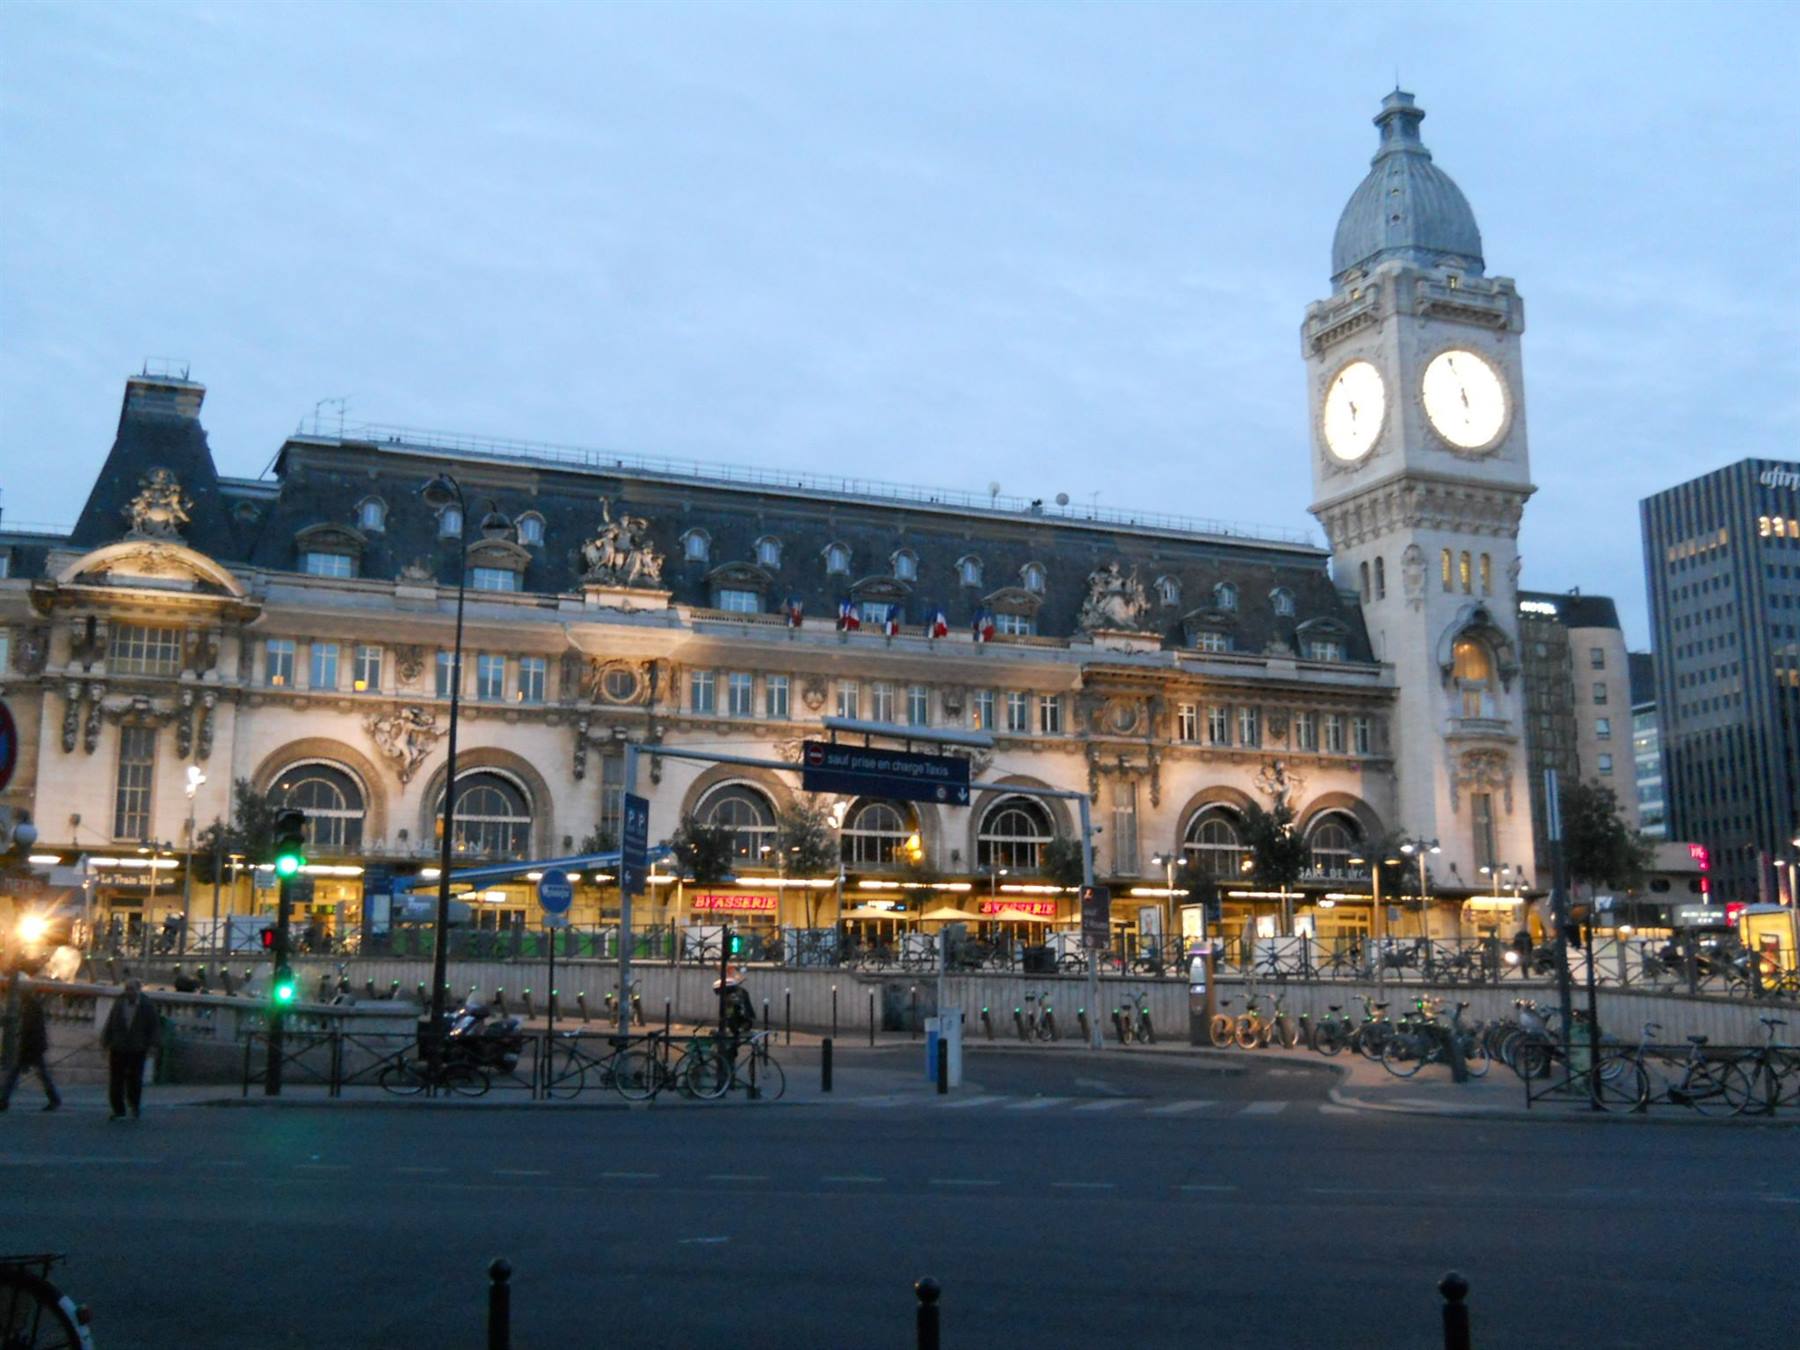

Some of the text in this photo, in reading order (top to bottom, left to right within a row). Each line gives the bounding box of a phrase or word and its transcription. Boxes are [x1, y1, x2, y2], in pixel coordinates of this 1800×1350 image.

[827, 754, 949, 776] sauf prise en charge Taxis
[101, 874, 112, 884] Le
[114, 873, 138, 885] Train
[695, 895, 777, 909] BRASSERIE
